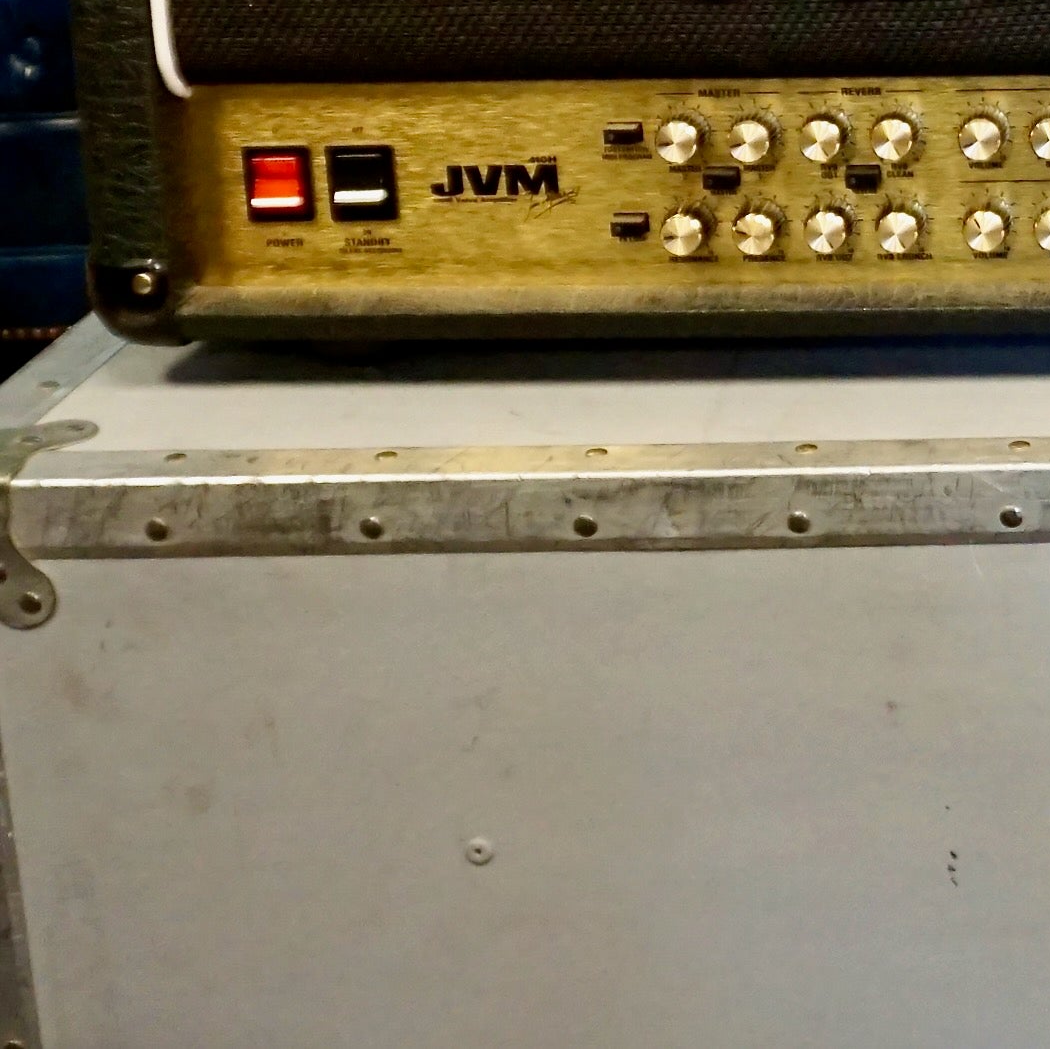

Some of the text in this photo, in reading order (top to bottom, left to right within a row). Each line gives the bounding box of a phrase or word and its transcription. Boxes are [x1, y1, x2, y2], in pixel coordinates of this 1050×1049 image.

[697, 88, 741, 98] MASTER
[840, 87, 882, 96] REVERB
[430, 164, 560, 197] JVM
[266, 238, 304, 247] POWER
[344, 237, 391, 247] STANDBY
